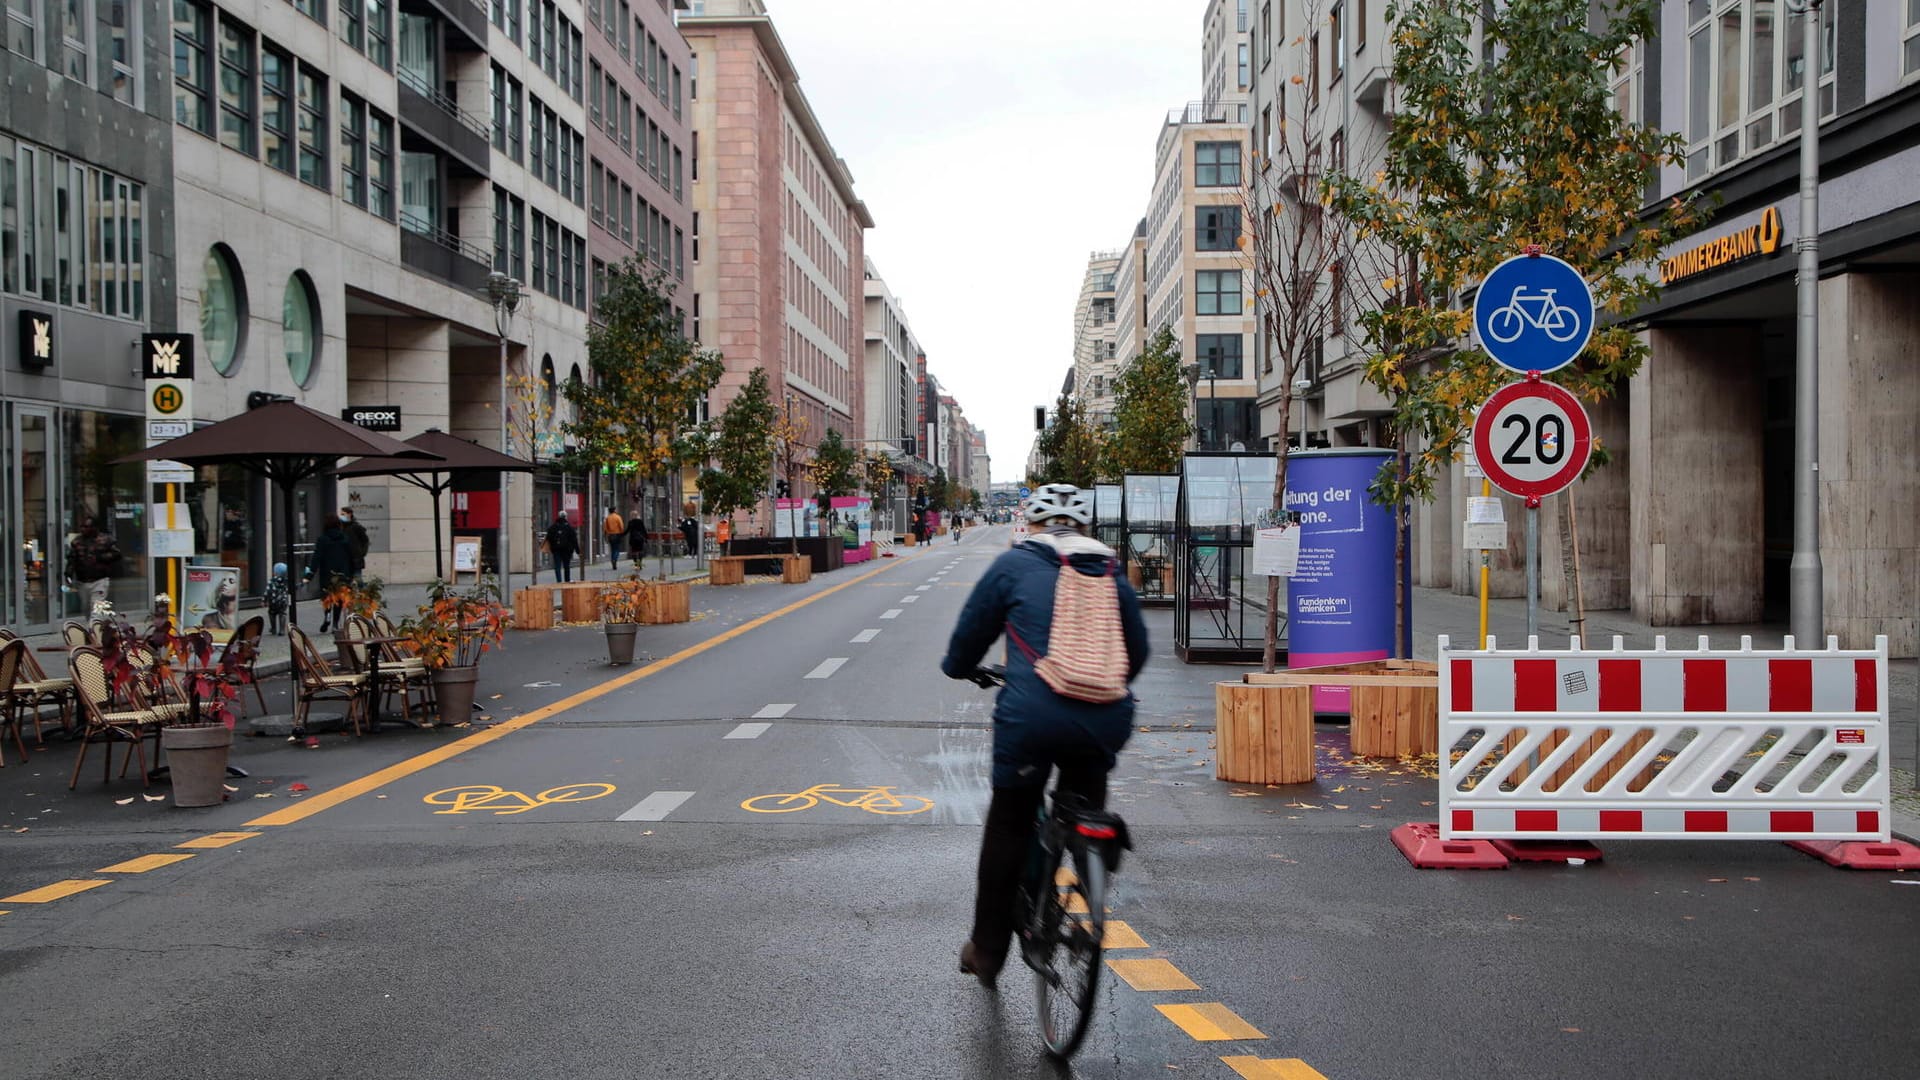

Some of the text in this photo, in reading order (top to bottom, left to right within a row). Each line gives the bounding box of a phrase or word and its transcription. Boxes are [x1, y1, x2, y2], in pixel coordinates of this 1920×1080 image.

[1660, 225, 1758, 284] COMMERZBANK
[159, 391, 175, 407] H
[353, 411, 396, 421] GEOX
[153, 426, 163, 434] 23
[1501, 413, 1564, 465] 20
[1323, 487, 1352, 502] der
